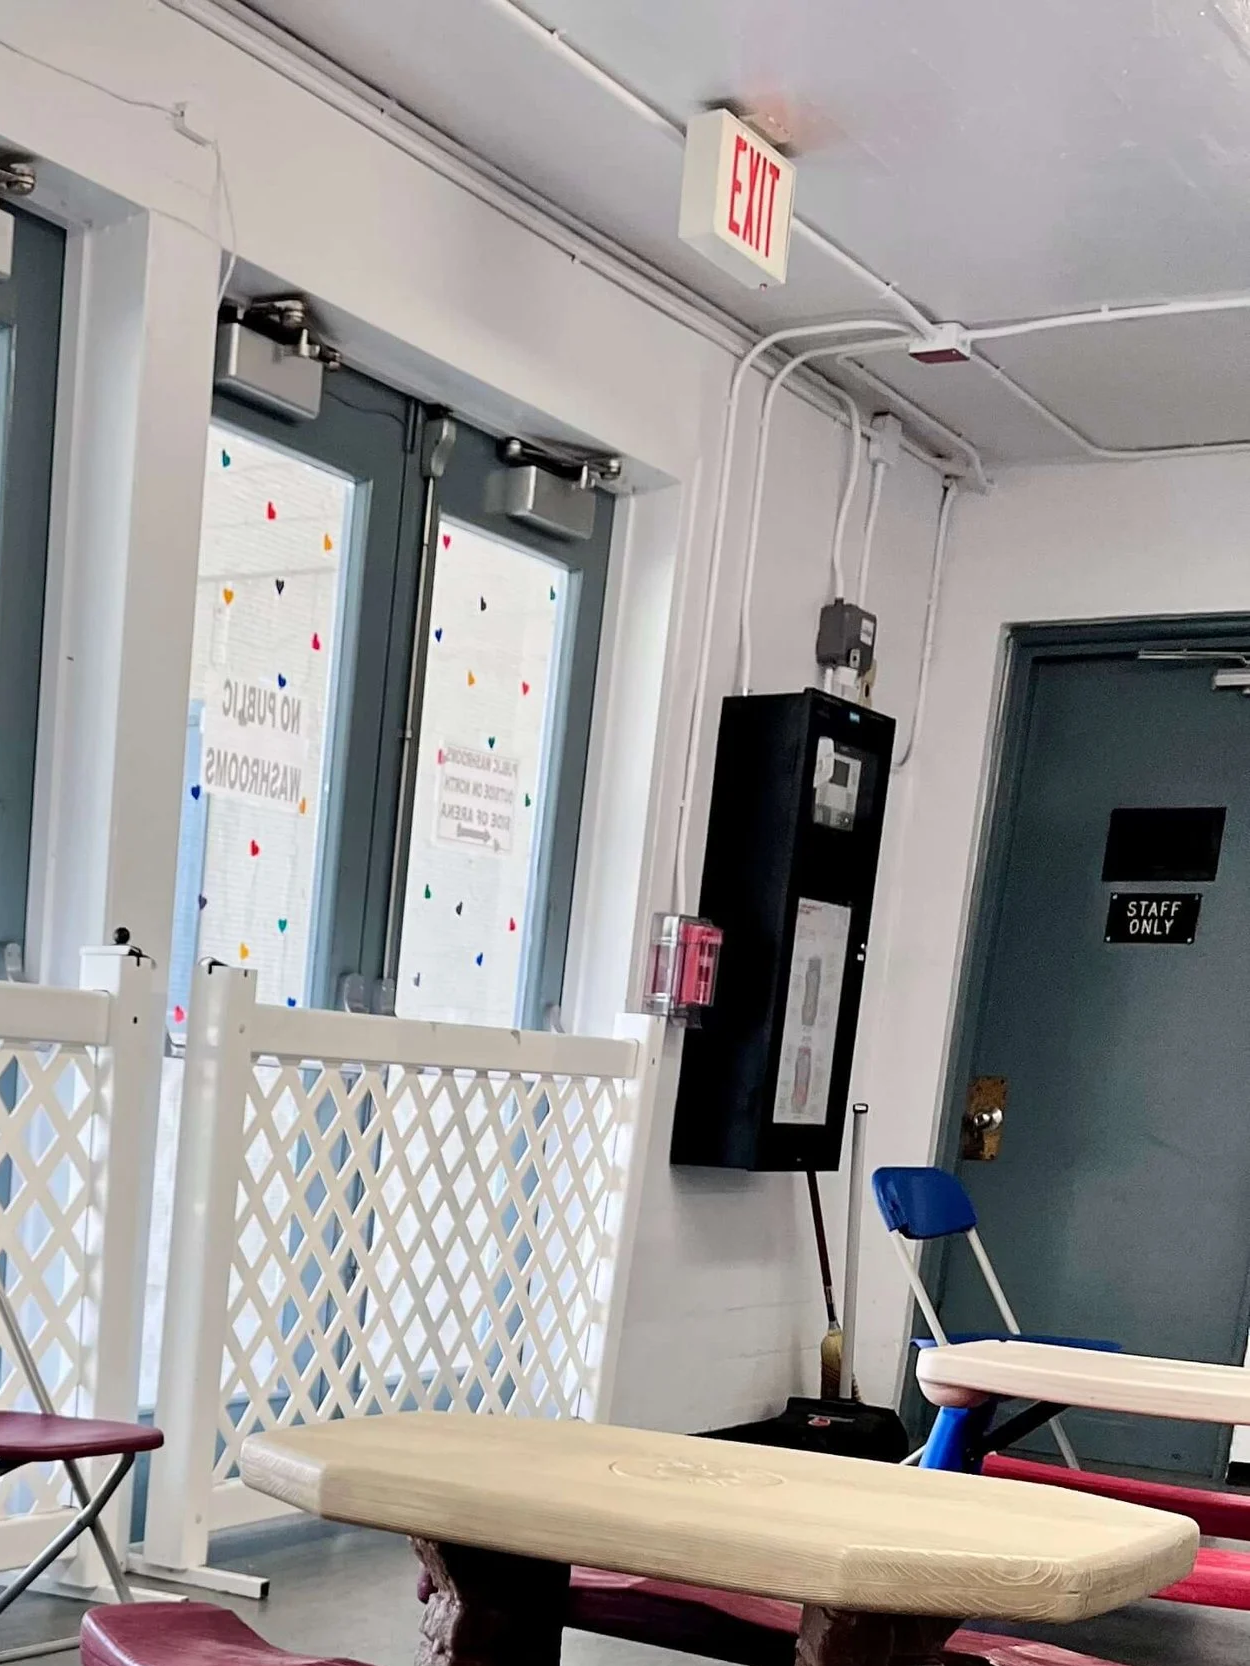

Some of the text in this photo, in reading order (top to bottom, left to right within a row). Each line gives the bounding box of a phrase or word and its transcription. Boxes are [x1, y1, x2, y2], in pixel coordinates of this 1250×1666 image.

[728, 134, 781, 258] EXIT
[1126, 900, 1183, 917] STAFF
[1129, 918, 1175, 935] ONLY
